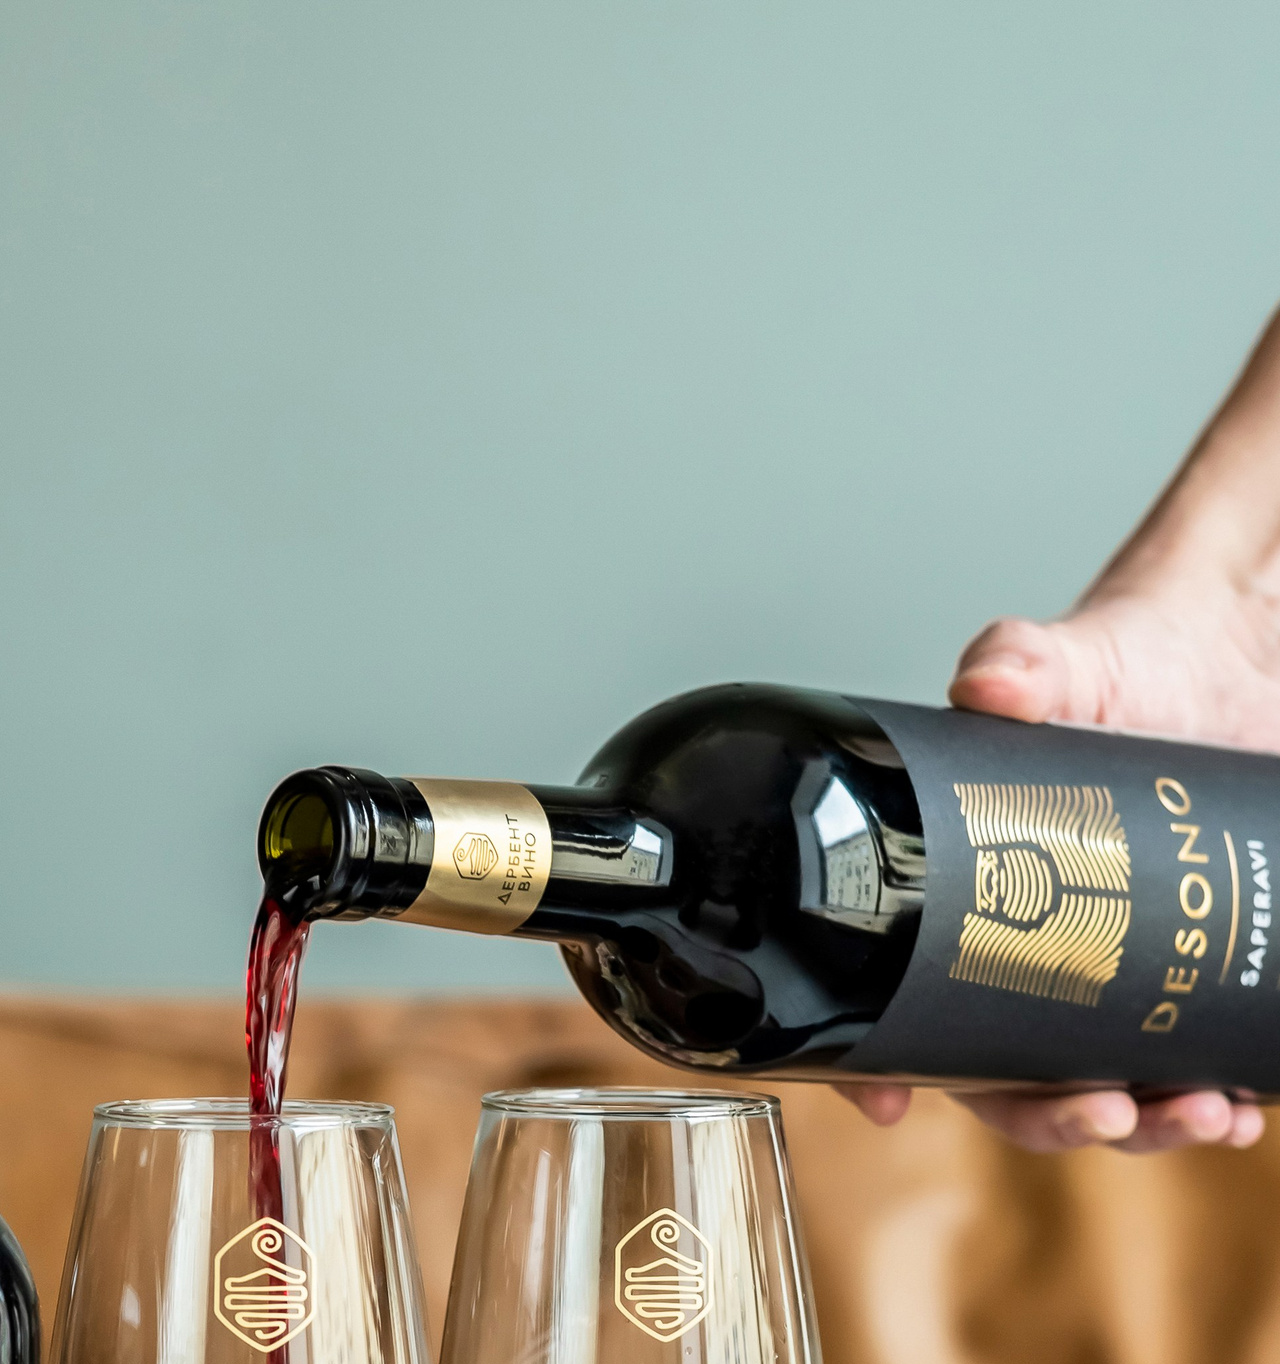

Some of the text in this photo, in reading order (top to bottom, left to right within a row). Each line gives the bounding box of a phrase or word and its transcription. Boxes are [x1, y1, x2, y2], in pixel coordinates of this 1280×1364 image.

[497, 813, 521, 905] ДЕРБЕНТ
[518, 832, 536, 891] ВИНО
[1141, 777, 1213, 1032] DESONO
[1240, 839, 1272, 988] SAPERAVI
